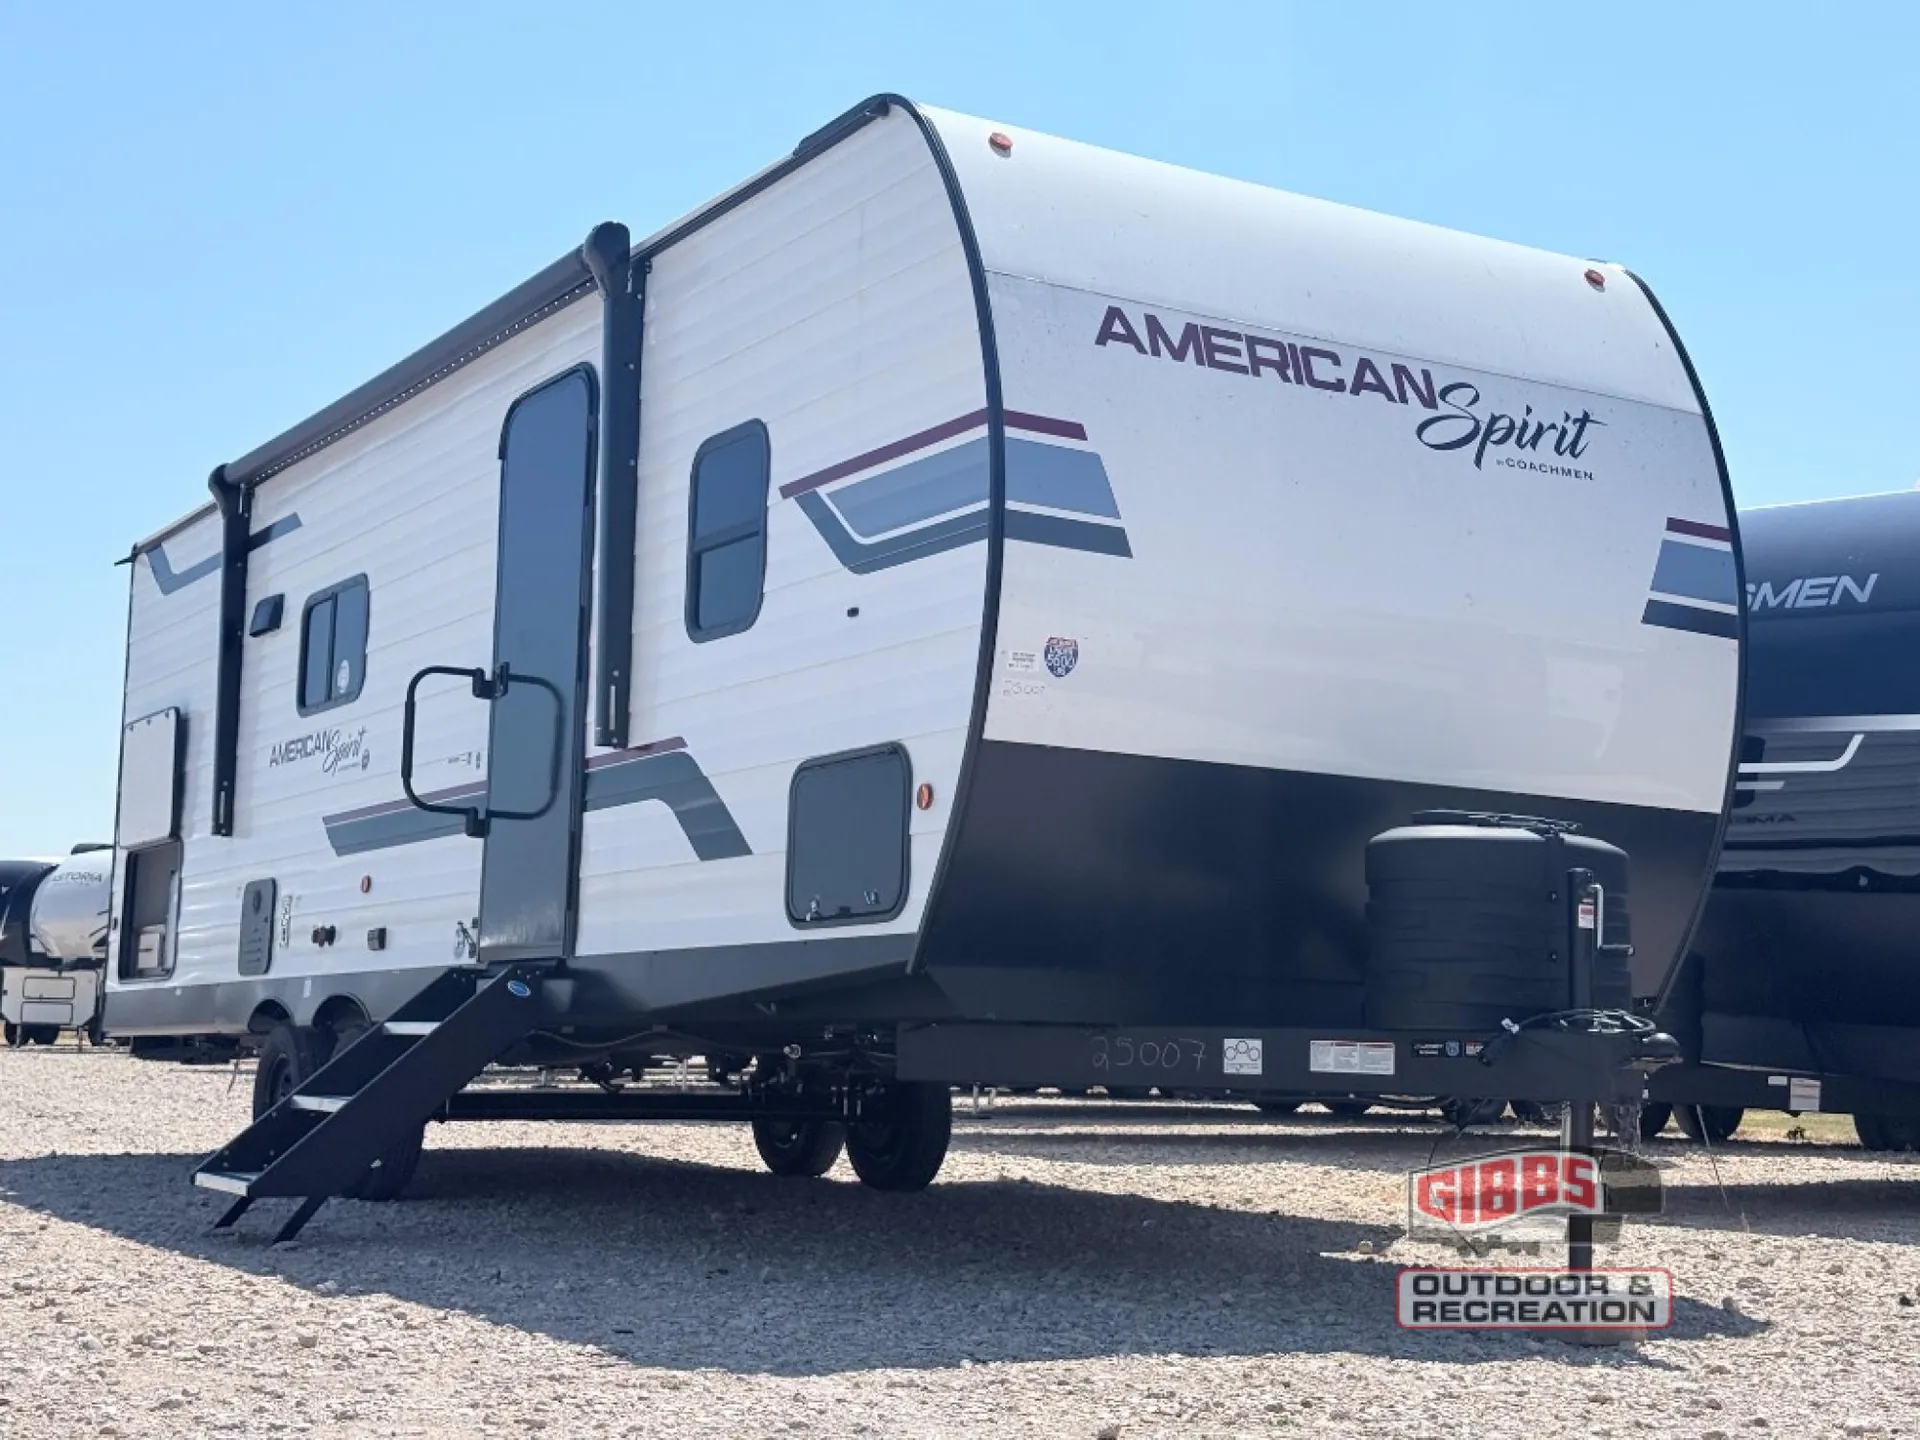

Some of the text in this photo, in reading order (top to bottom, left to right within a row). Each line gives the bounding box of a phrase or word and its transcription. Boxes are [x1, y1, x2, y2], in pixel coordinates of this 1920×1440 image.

[1094, 305, 1608, 471] AMERICAN Spirit
[1505, 457, 1593, 480] COACHMEN
[269, 728, 333, 768] AMERICAN
[1092, 1036, 1206, 1072] 25007
